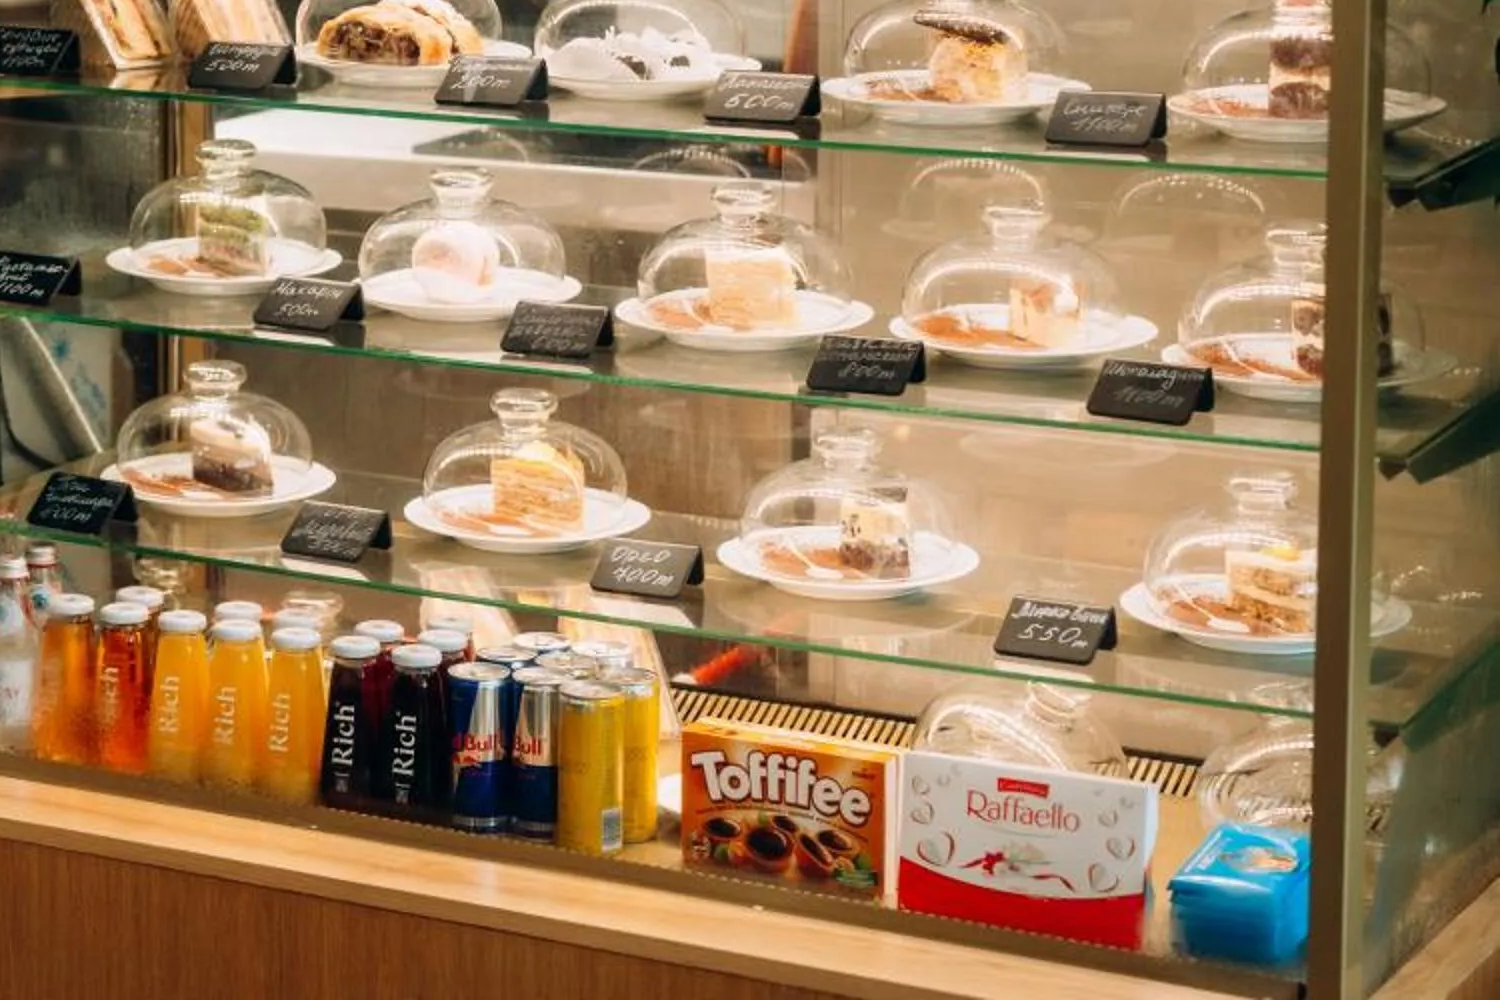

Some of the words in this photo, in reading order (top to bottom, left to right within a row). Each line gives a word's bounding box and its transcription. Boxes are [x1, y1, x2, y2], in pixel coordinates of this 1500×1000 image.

[157, 675, 180, 734] Rich
[212, 685, 237, 746] Rich
[267, 692, 291, 753] Rich
[331, 704, 355, 767] Rich
[392, 714, 417, 777] Rich
[691, 750, 872, 828] Toffifee
[966, 789, 1082, 833] Raffaello
